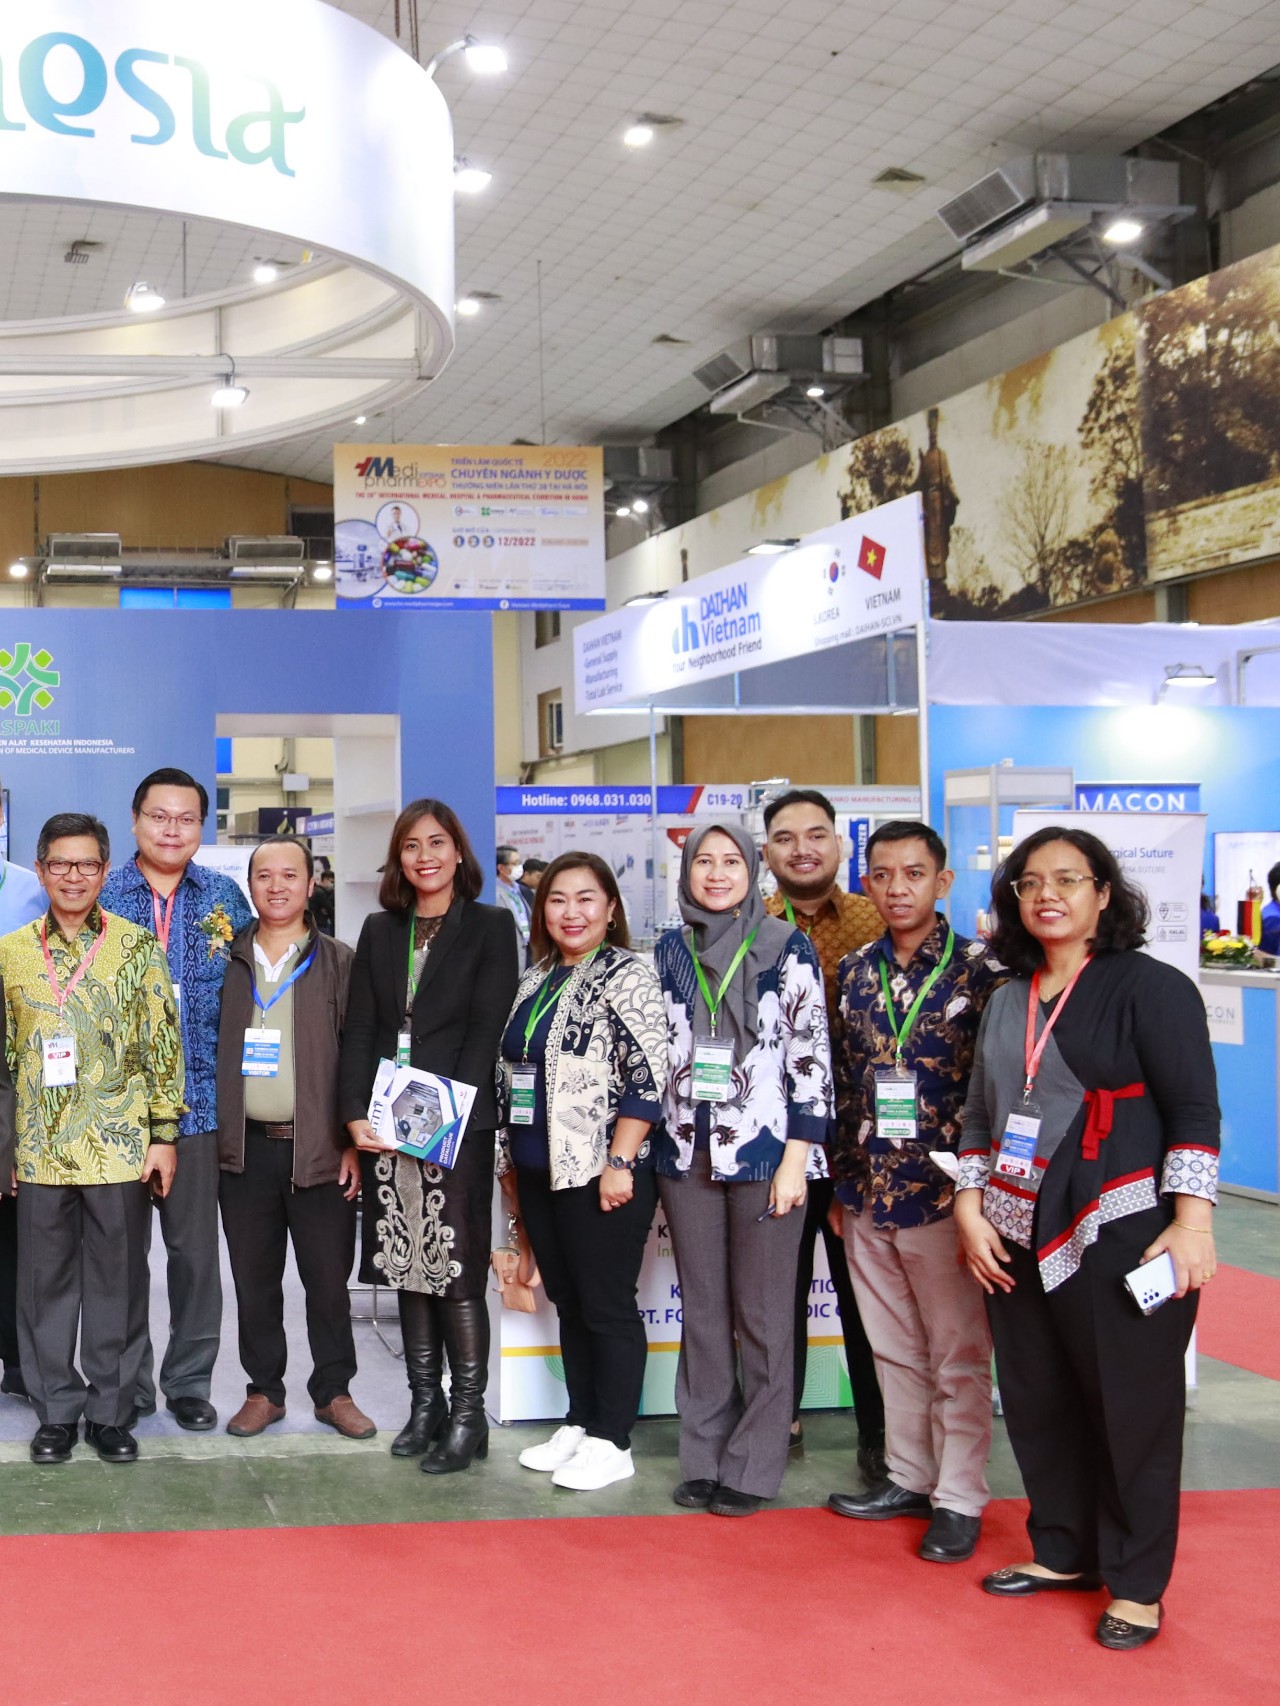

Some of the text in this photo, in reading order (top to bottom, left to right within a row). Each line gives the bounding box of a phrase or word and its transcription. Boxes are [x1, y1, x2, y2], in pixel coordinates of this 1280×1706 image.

[543, 451, 588, 467] 2022
[544, 470, 551, 479] Y
[498, 536, 536, 547] 12/2022
[865, 588, 901, 610] VIETNAM
[701, 612, 761, 646] Vietnam
[738, 637, 762, 655] Friend
[522, 794, 651, 806] Hotline: 0968.031.030
[707, 793, 743, 805] C19-20
[1079, 793, 1185, 811] MACON
[858, 823, 868, 878] NEBULIZER
[1110, 847, 1174, 859] rgical Suture
[1206, 1005, 1235, 1019] CON
[439, 1137, 448, 1162] PRODUCT
[443, 1132, 454, 1164] CATALOGUE
[1005, 1165, 1021, 1173] VIP
